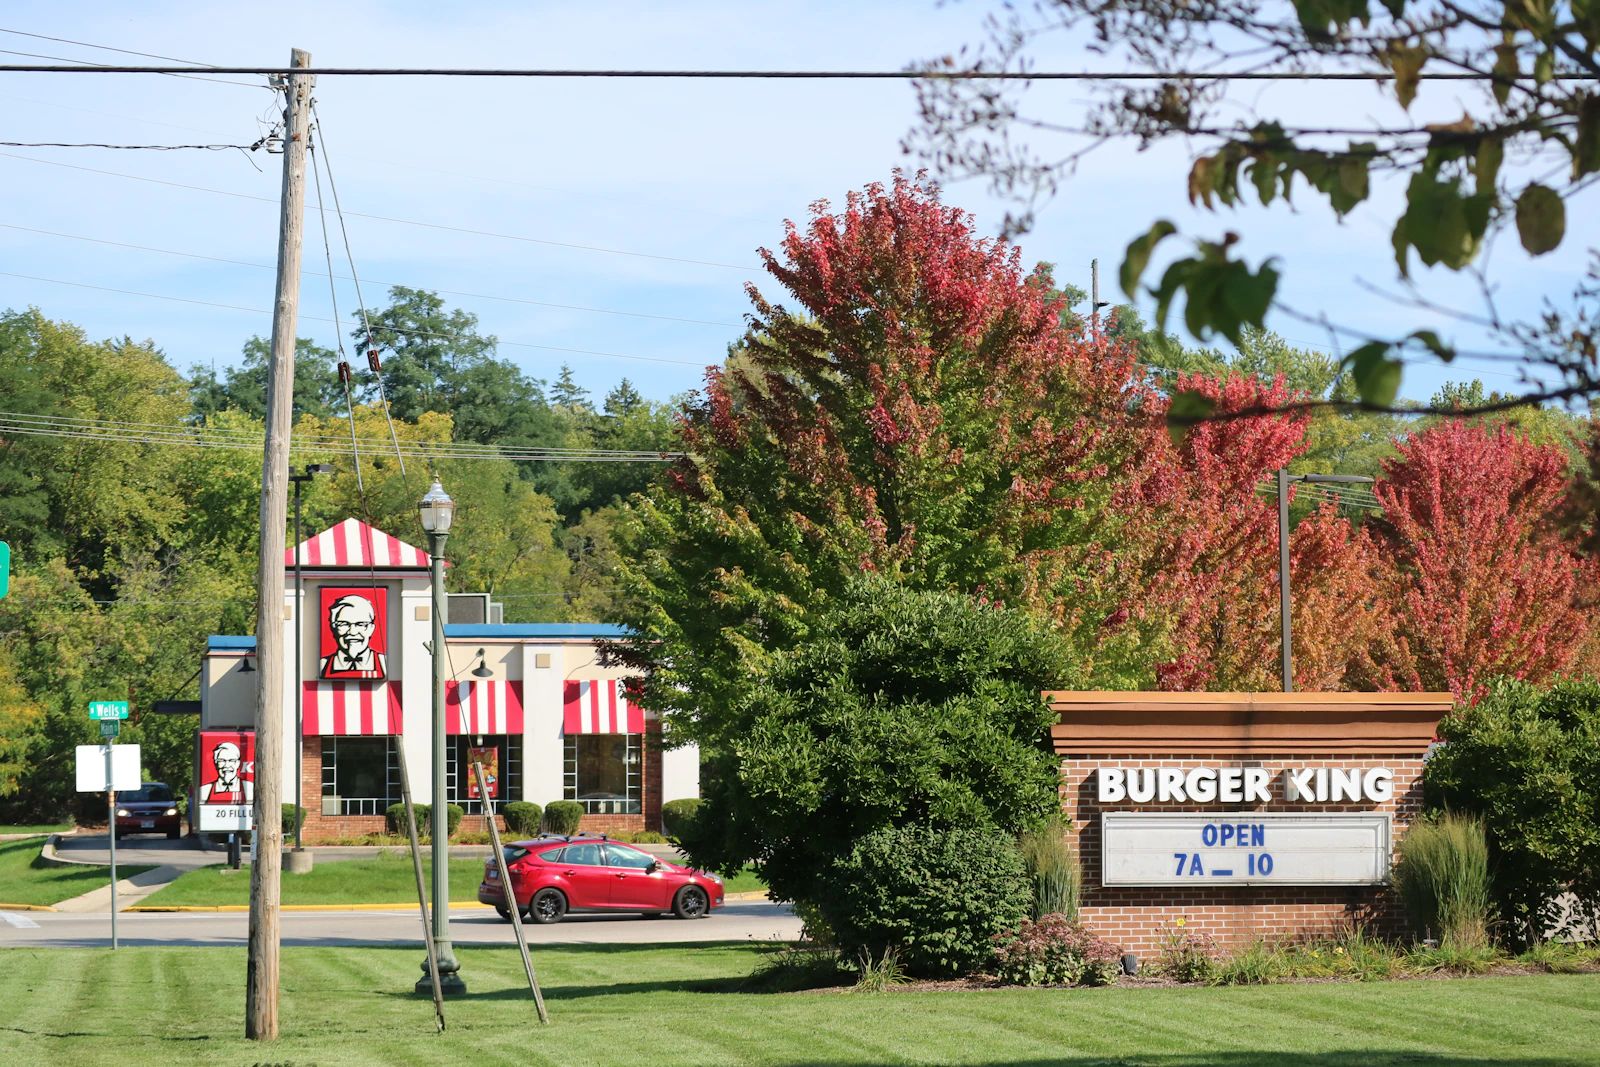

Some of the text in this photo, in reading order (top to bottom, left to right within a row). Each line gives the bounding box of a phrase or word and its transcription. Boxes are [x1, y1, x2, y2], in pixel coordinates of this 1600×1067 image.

[96, 704, 120, 717] Wells
[1097, 767, 1394, 803] BURGER KING
[215, 809, 226, 818] 20
[229, 809, 247, 818] FILL
[1202, 824, 1265, 847] OPEN
[1174, 853, 1204, 876] 7A
